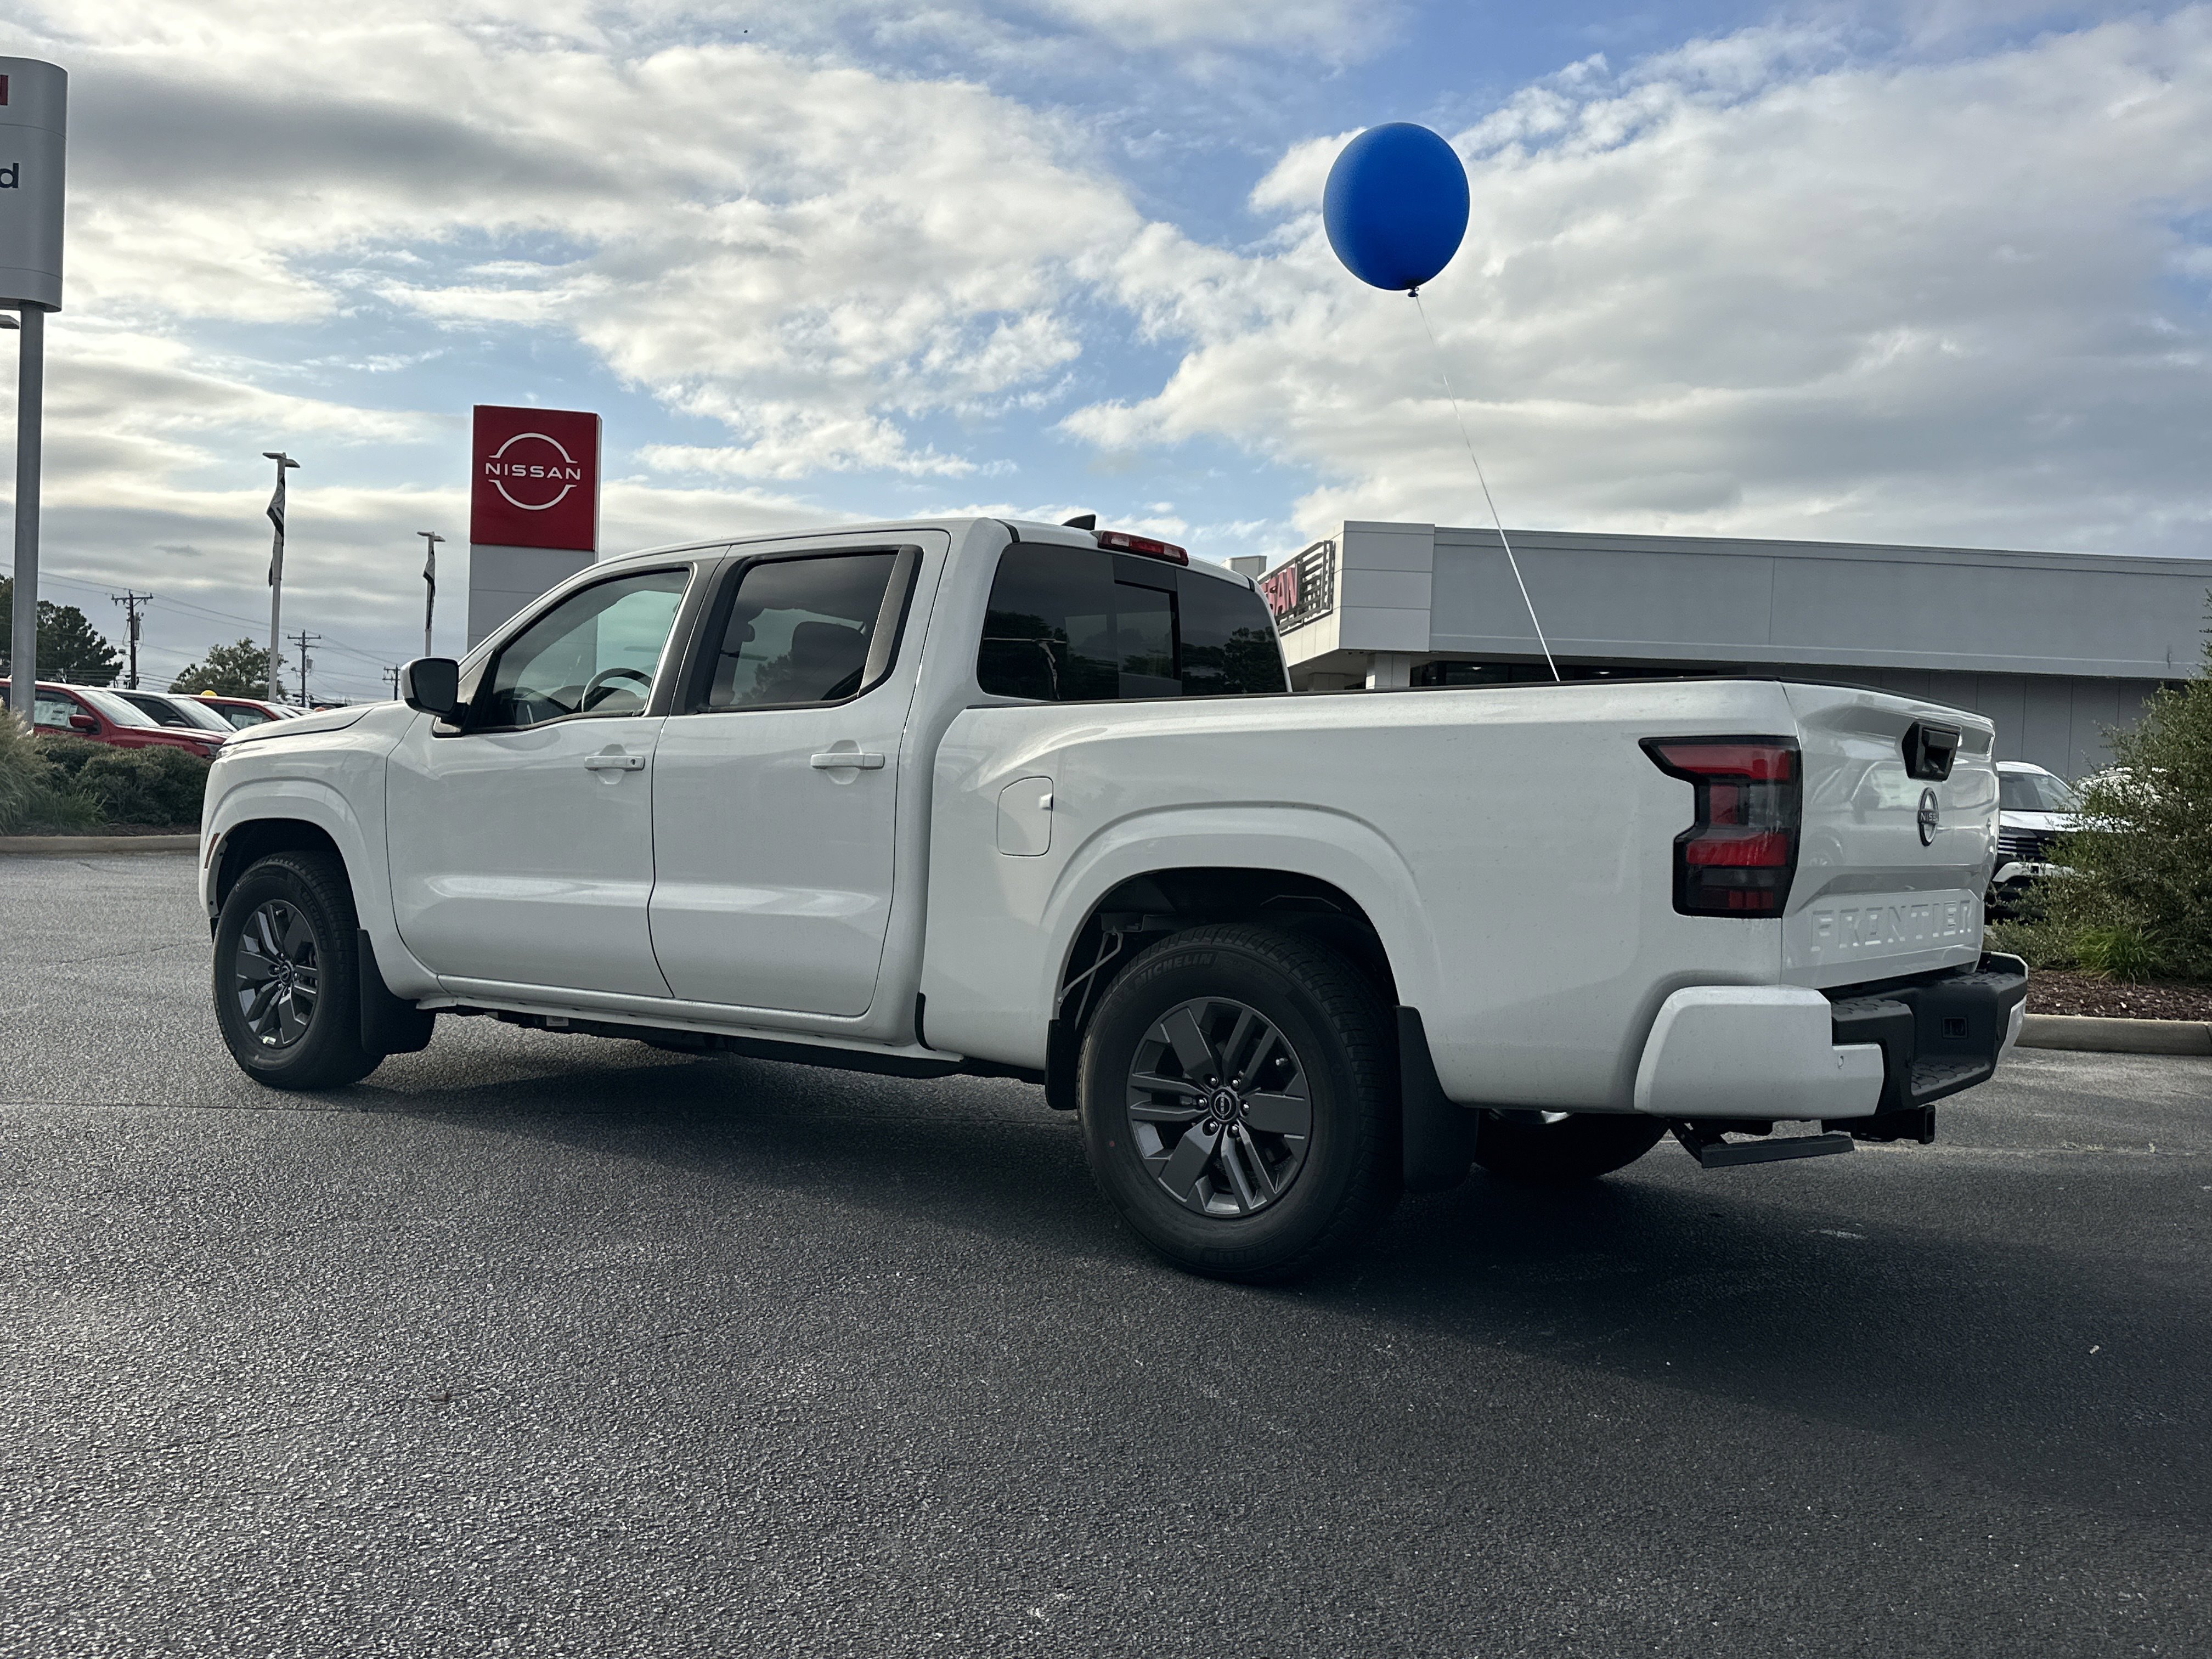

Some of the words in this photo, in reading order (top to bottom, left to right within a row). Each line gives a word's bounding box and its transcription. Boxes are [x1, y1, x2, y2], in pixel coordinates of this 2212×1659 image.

[485, 462, 581, 480] NISSAN
[1811, 900, 1971, 952] FRONTIER
[1135, 953, 1213, 990] MICHELIN
